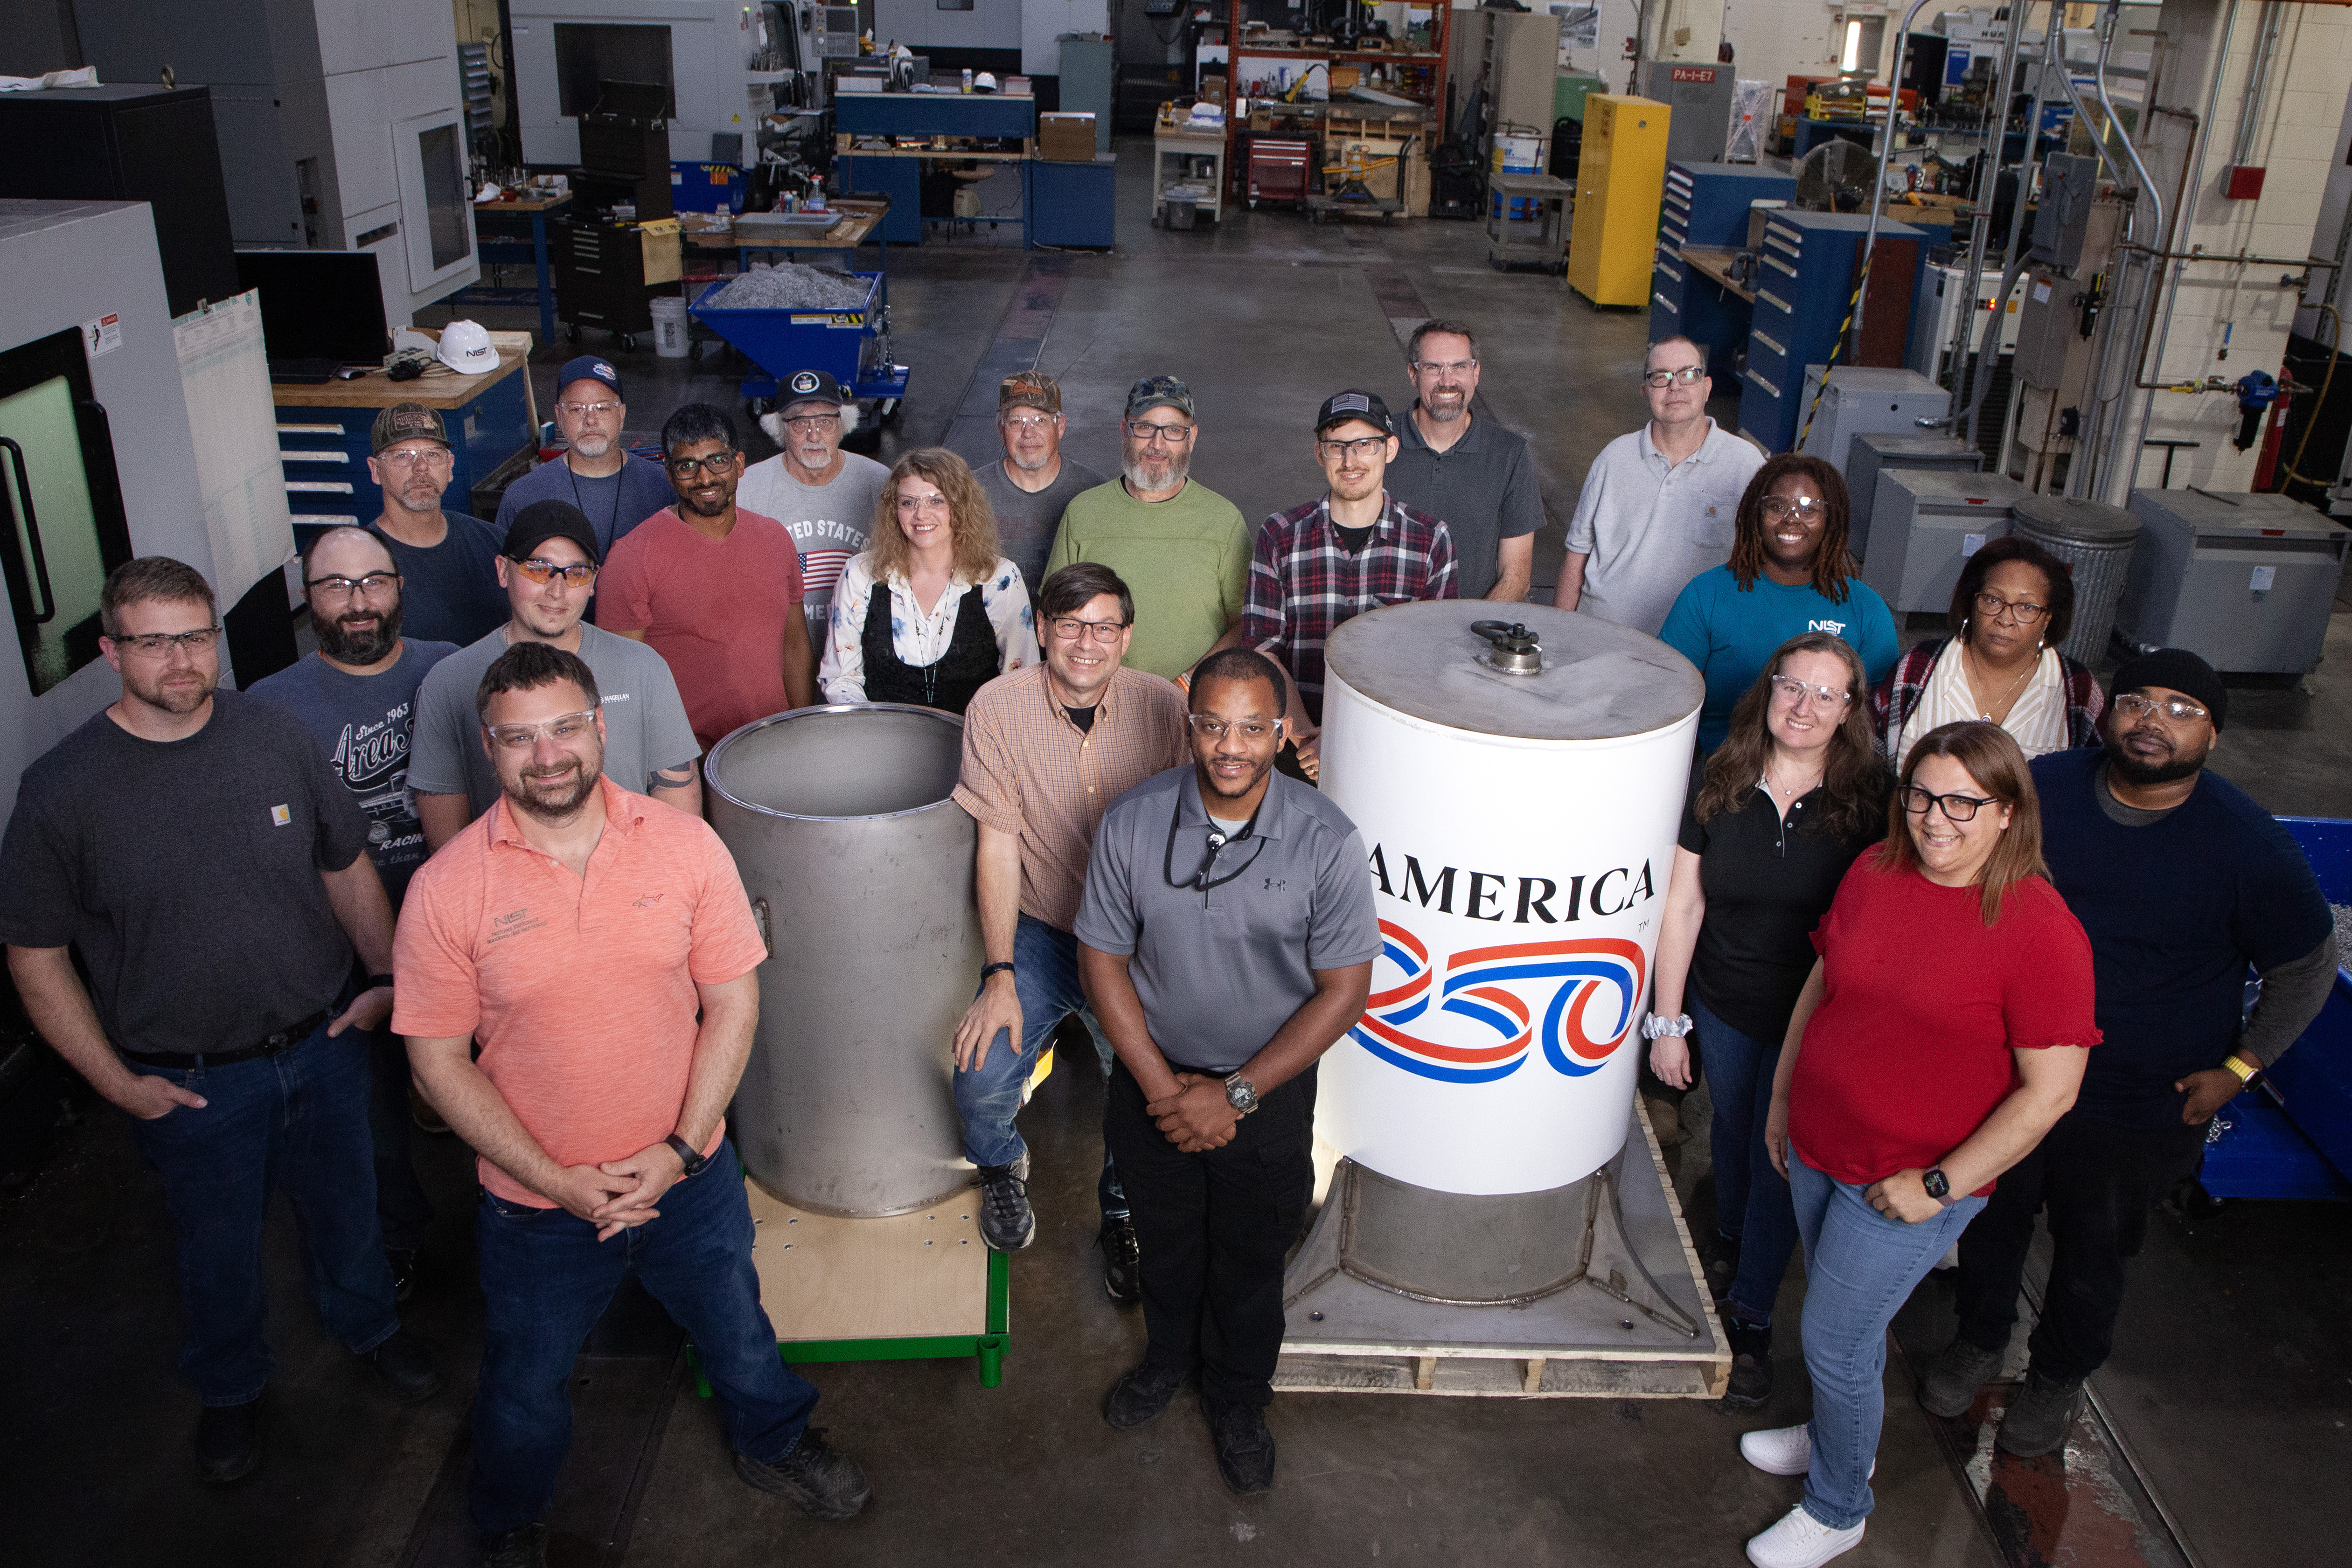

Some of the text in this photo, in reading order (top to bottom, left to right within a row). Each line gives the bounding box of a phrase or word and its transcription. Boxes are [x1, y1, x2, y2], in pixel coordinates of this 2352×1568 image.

[466, 347, 487, 357] NIST
[786, 519, 871, 553] TED STATES
[1808, 620, 1846, 635] NIST
[355, 702, 409, 741] Since 1963
[379, 833, 423, 851] RACIN
[1368, 841, 1654, 924] AMERICA
[494, 908, 528, 928] NIST
[1638, 918, 1649, 933] TM
